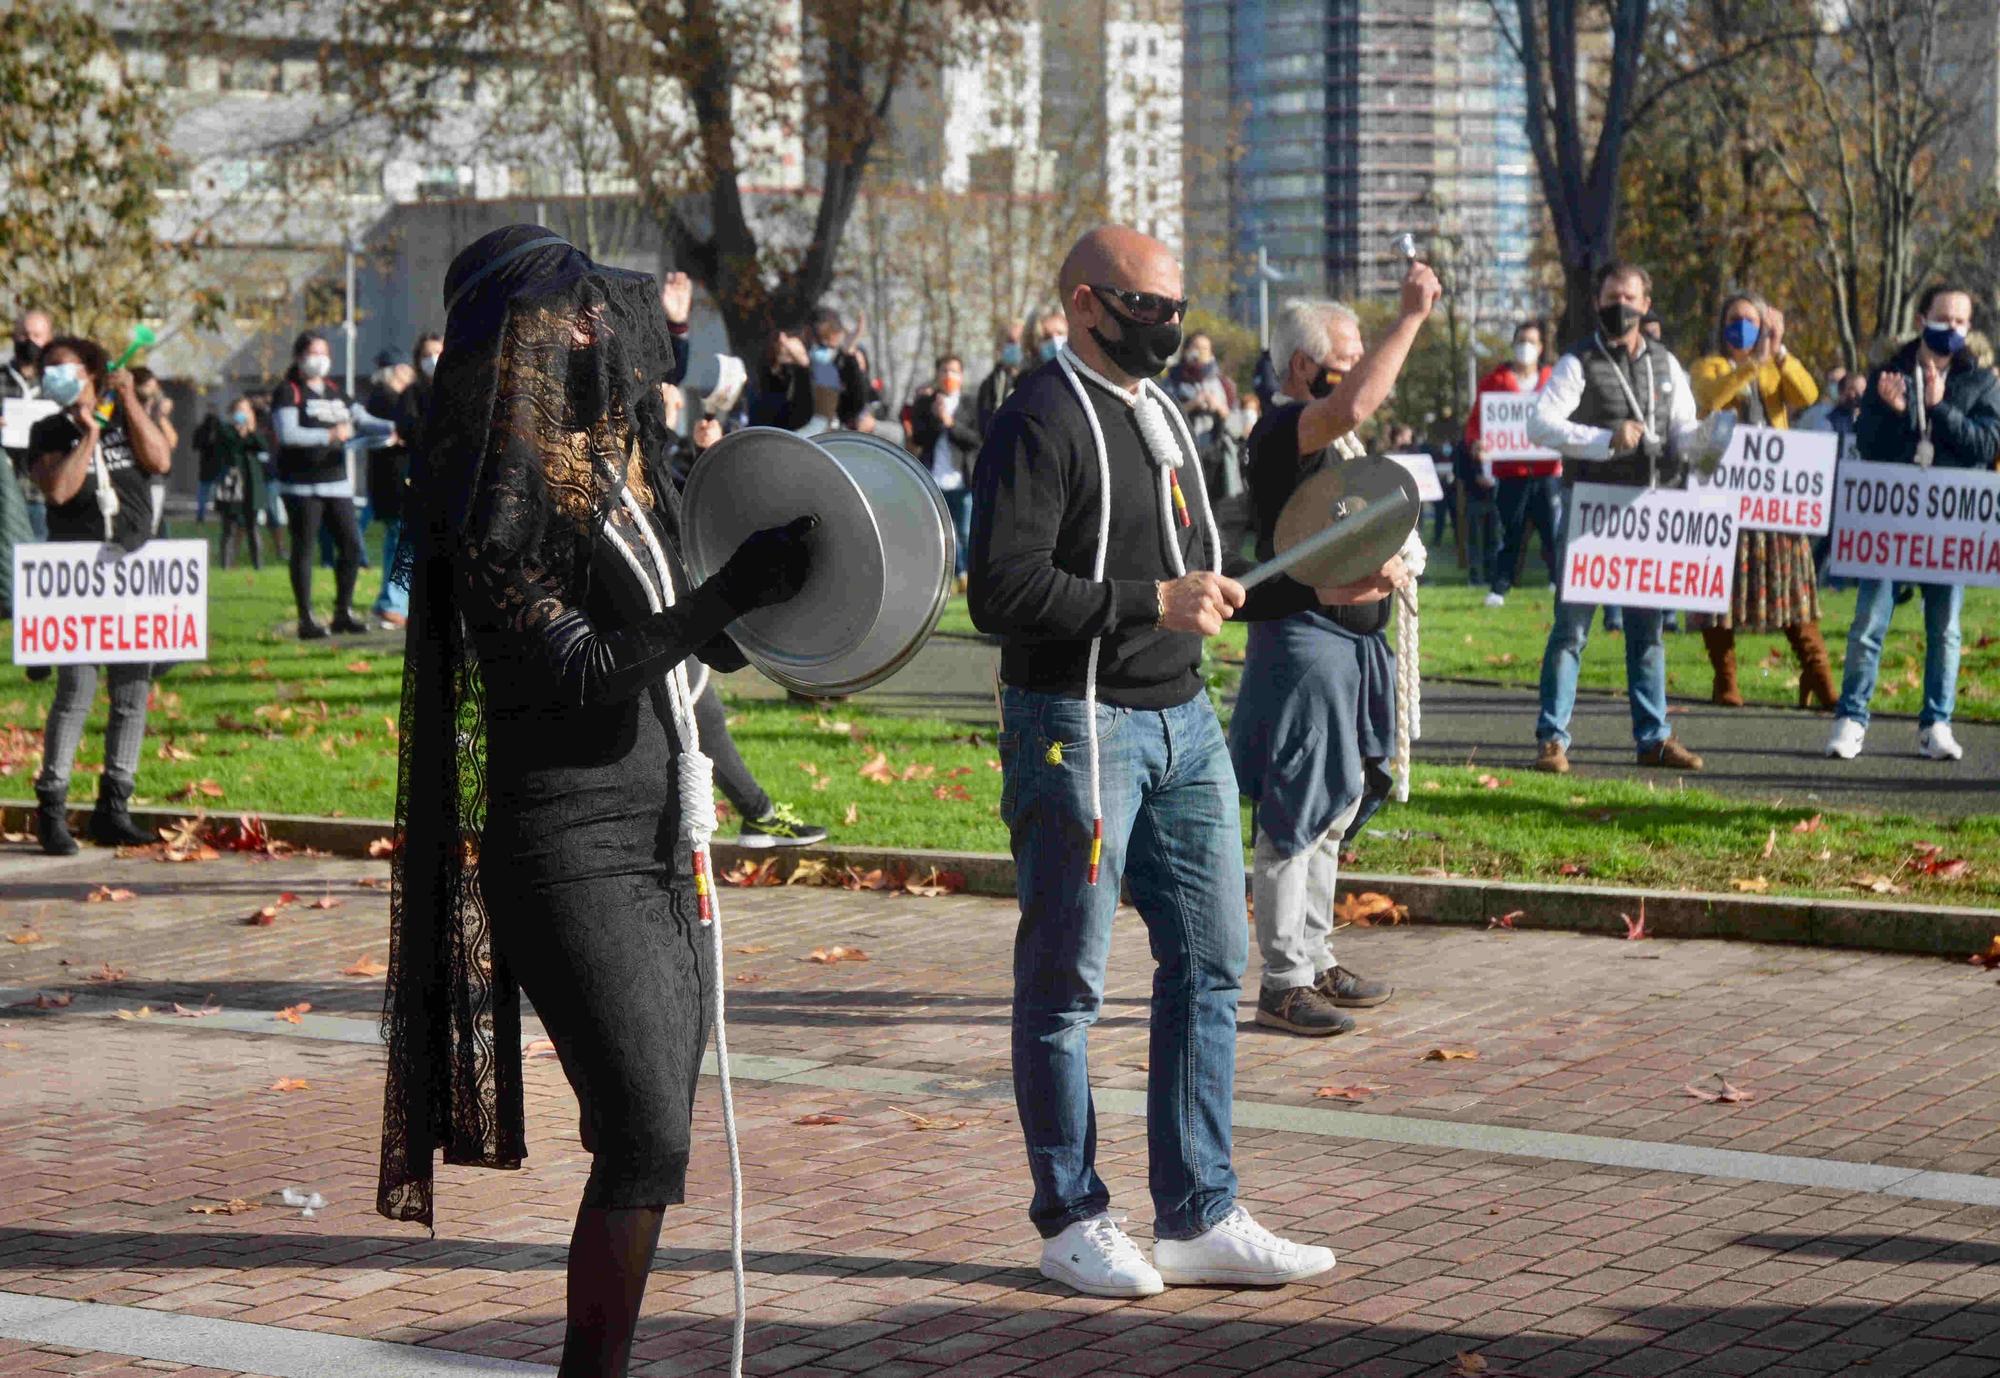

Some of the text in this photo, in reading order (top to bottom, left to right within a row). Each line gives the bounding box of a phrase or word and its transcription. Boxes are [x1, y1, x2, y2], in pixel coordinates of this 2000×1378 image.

[1487, 403, 1536, 421] SOMO
[1485, 431, 1530, 450] SOLU
[1743, 433, 1784, 463] NO
[1713, 465, 1823, 497] OMOS LOS
[1844, 478, 1920, 517] TODOS
[1580, 503, 1732, 548] TODOS SOMOS
[1740, 496, 1822, 528] PABLES
[1837, 528, 2000, 574] HOSTELERÍA
[22, 558, 199, 597] TODOS SOMOS
[1571, 553, 1724, 598] HOSTELERÍA
[21, 604, 198, 653] HOSTELERÍA
